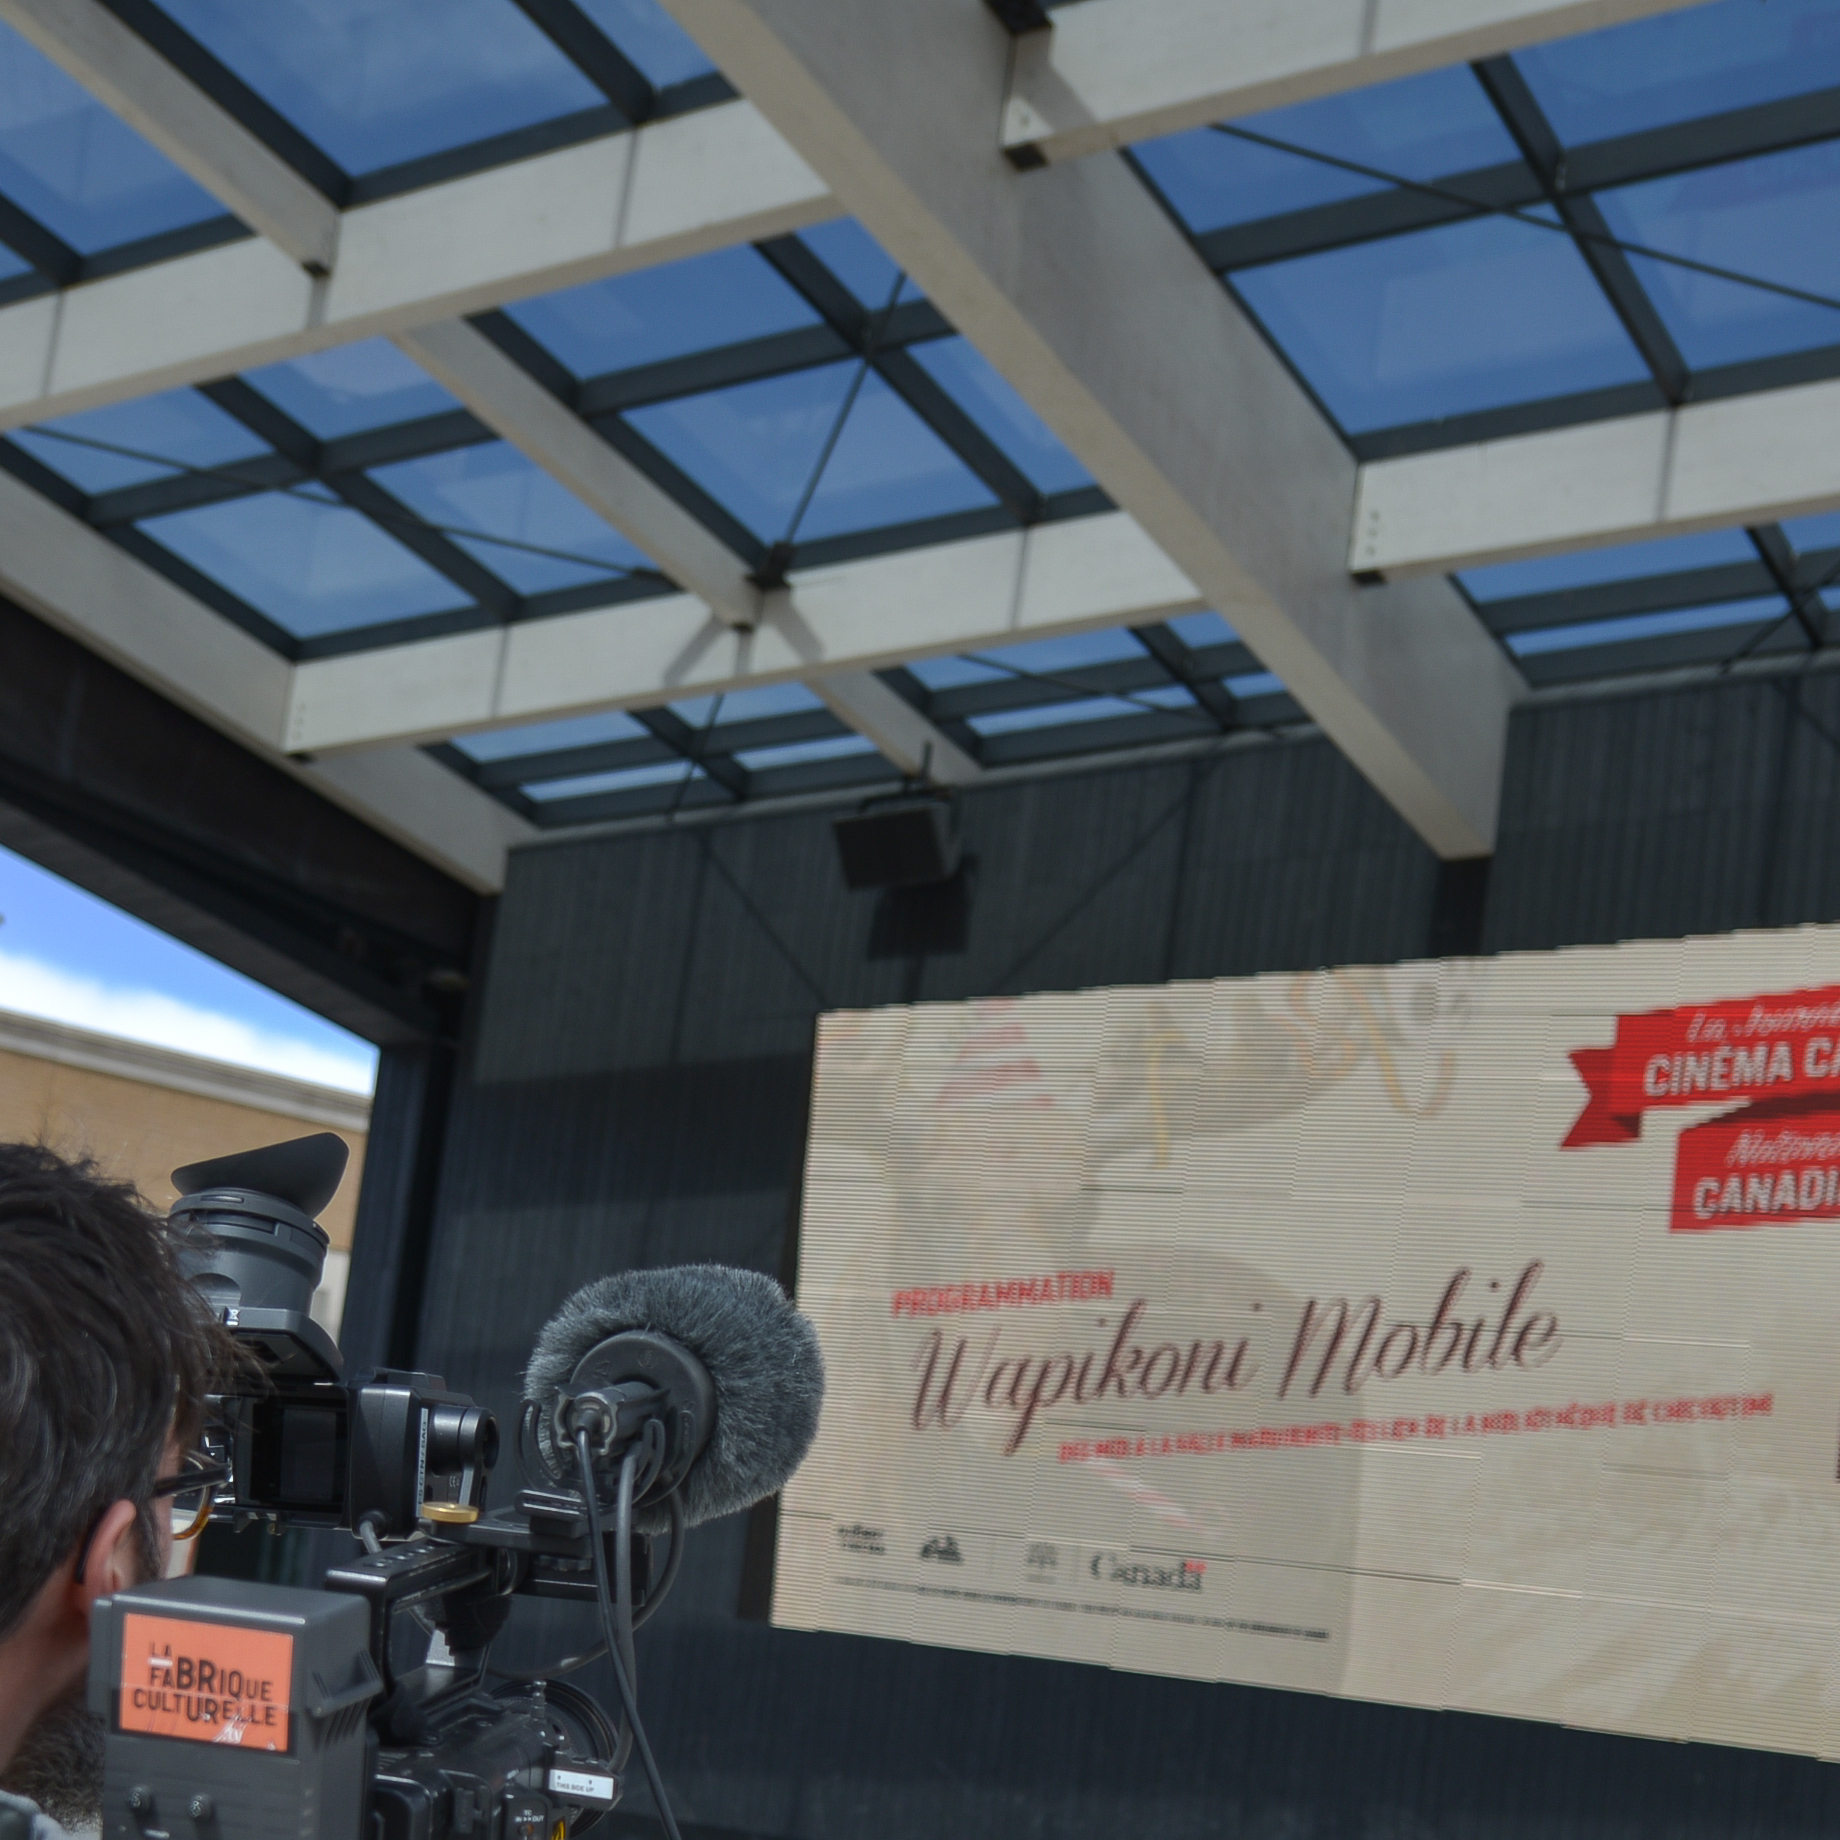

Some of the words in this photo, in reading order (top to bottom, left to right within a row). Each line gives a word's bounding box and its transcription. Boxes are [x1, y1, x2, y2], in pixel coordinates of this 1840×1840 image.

[892, 1267, 1114, 1318] PROGRAMMATION
[909, 1297, 1262, 1456] Wapikoni
[1277, 1258, 1562, 1400] Mobile
[150, 1642, 172, 1657] LA
[150, 1657, 273, 1701] FABRIQUE
[133, 1688, 277, 1726] CULTURELLE
[571, 1784, 585, 1792] SIDE
